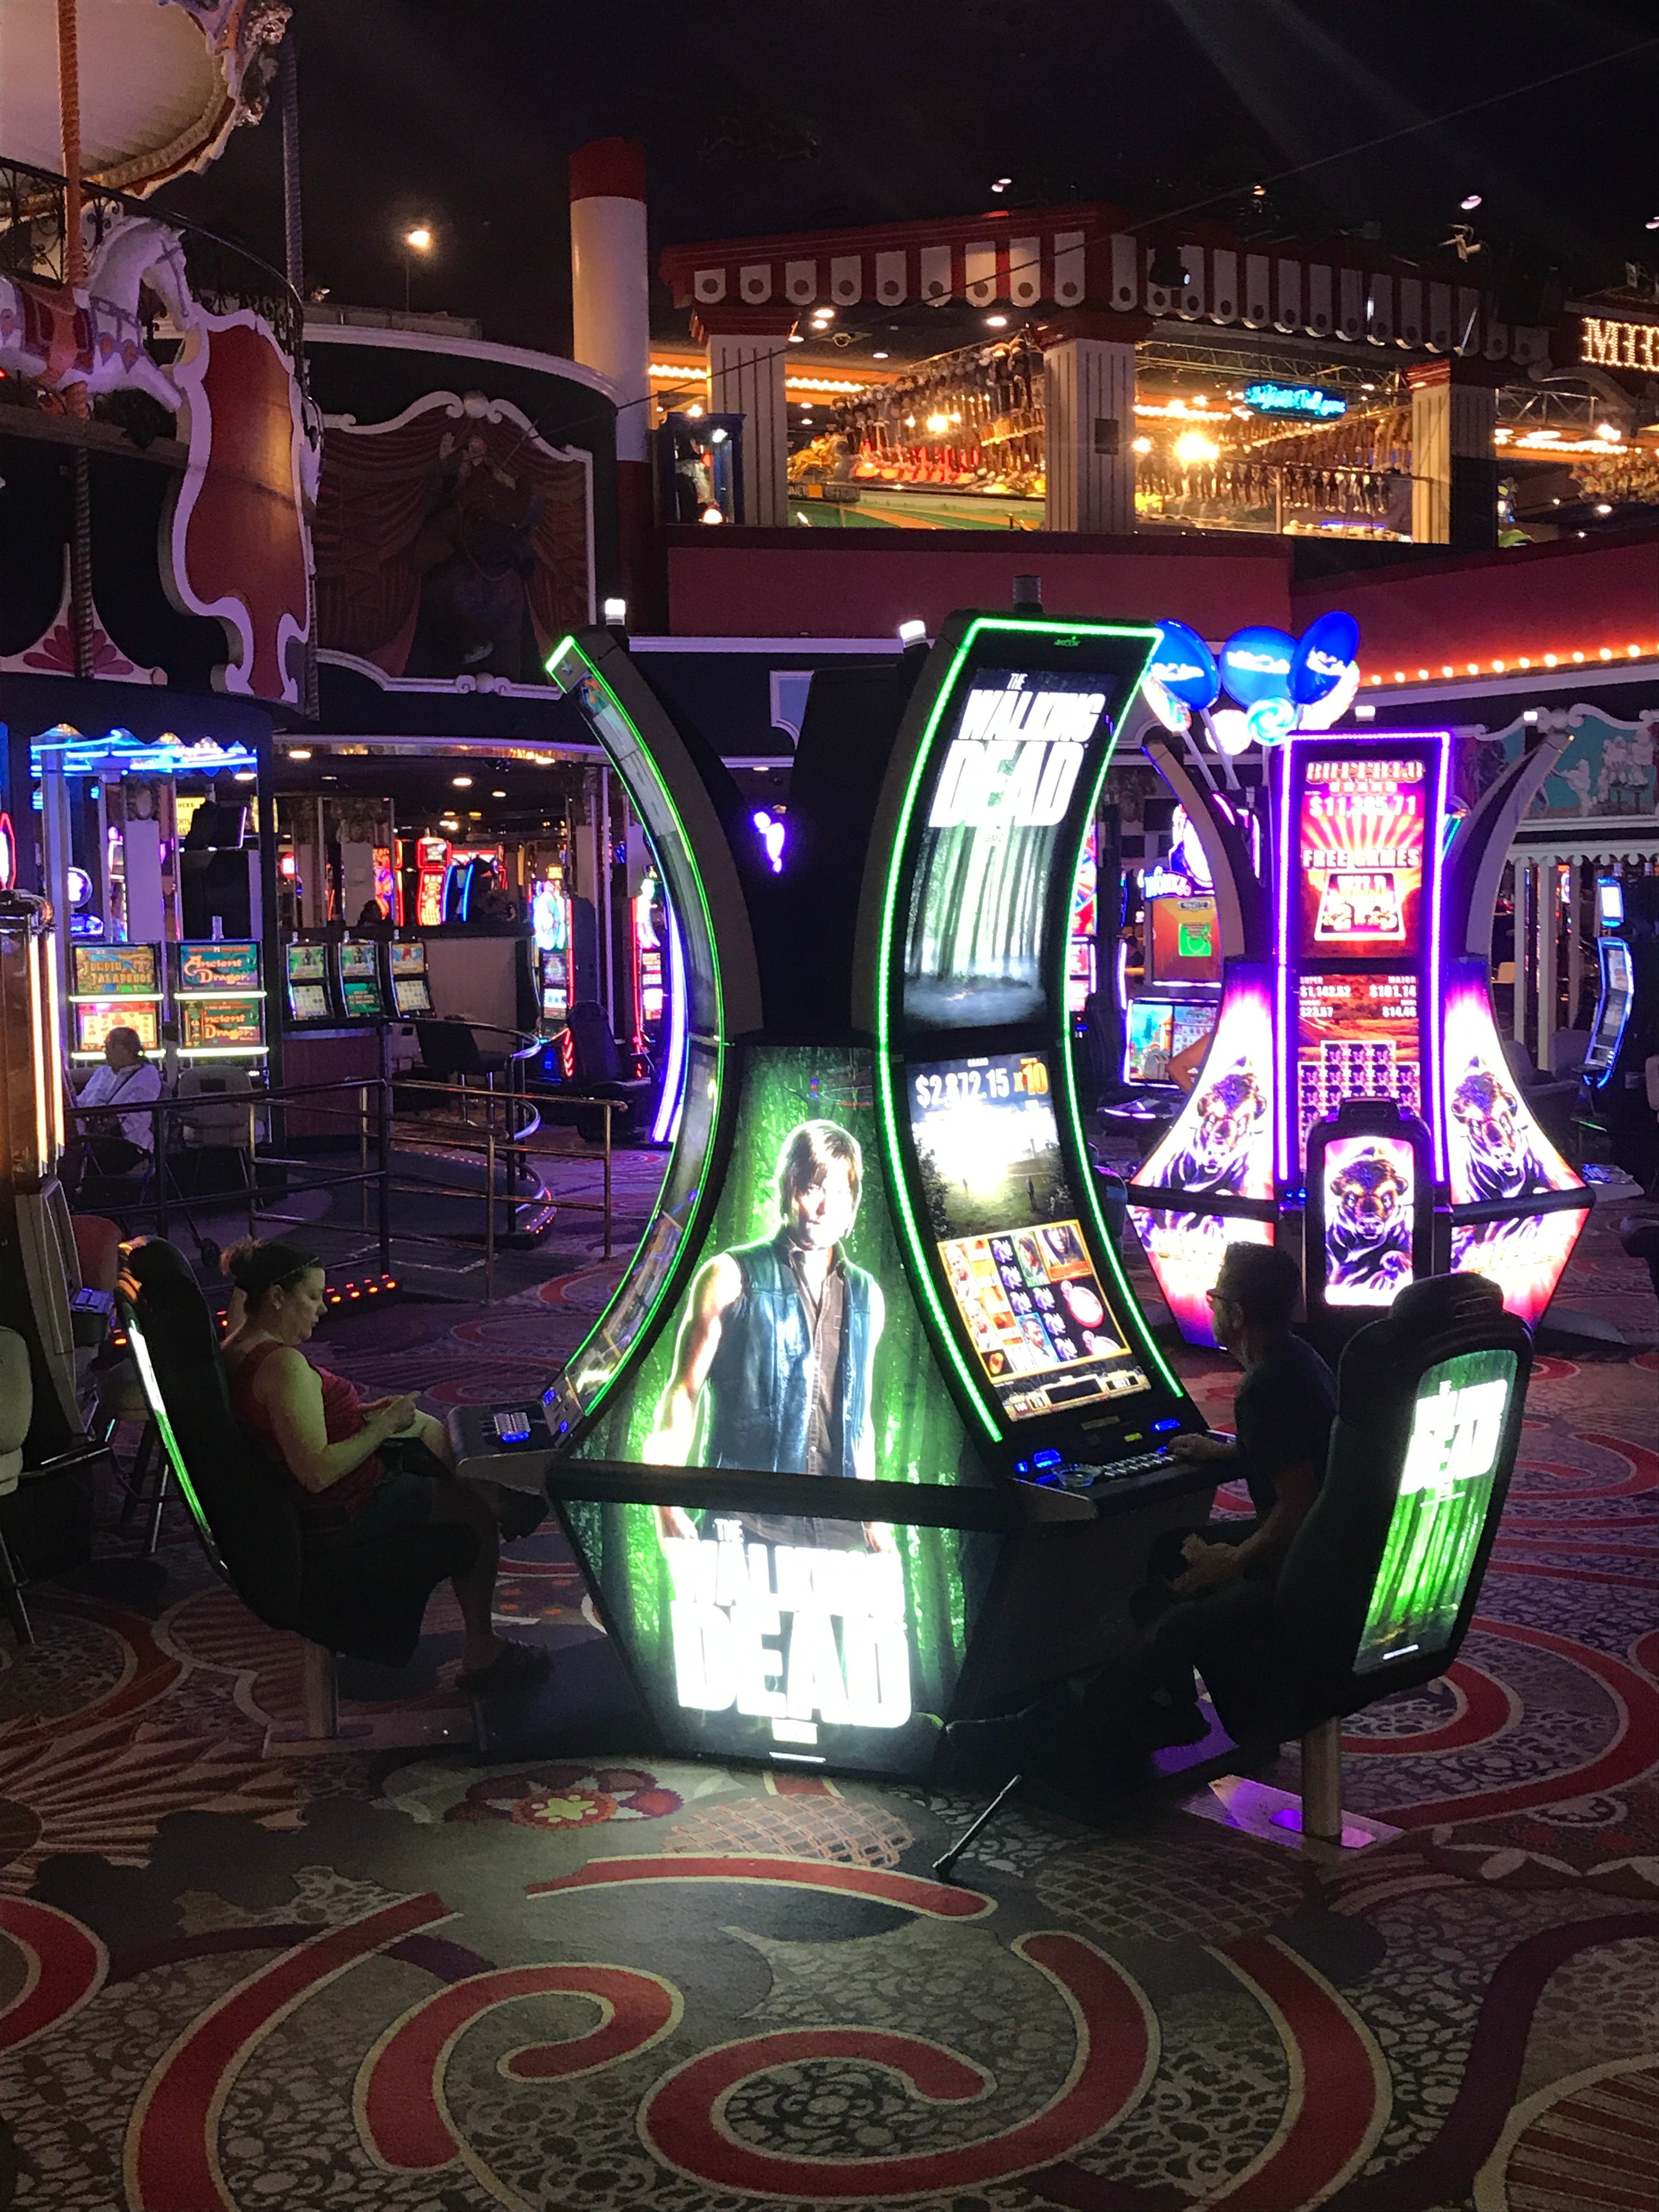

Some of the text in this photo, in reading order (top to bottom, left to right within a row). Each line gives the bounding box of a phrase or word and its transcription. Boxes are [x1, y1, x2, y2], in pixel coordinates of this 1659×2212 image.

[1007, 673, 1028, 690] THE
[958, 689, 1105, 742] WALKING
[928, 739, 1084, 827] DEAD
[1302, 848, 1420, 868] FREE GAMES
[204, 1013, 245, 1024] ncient
[916, 1063, 1048, 1108] $2,872.15 x10
[714, 1519, 744, 1543] THE
[670, 1599, 912, 1728] DEAD
